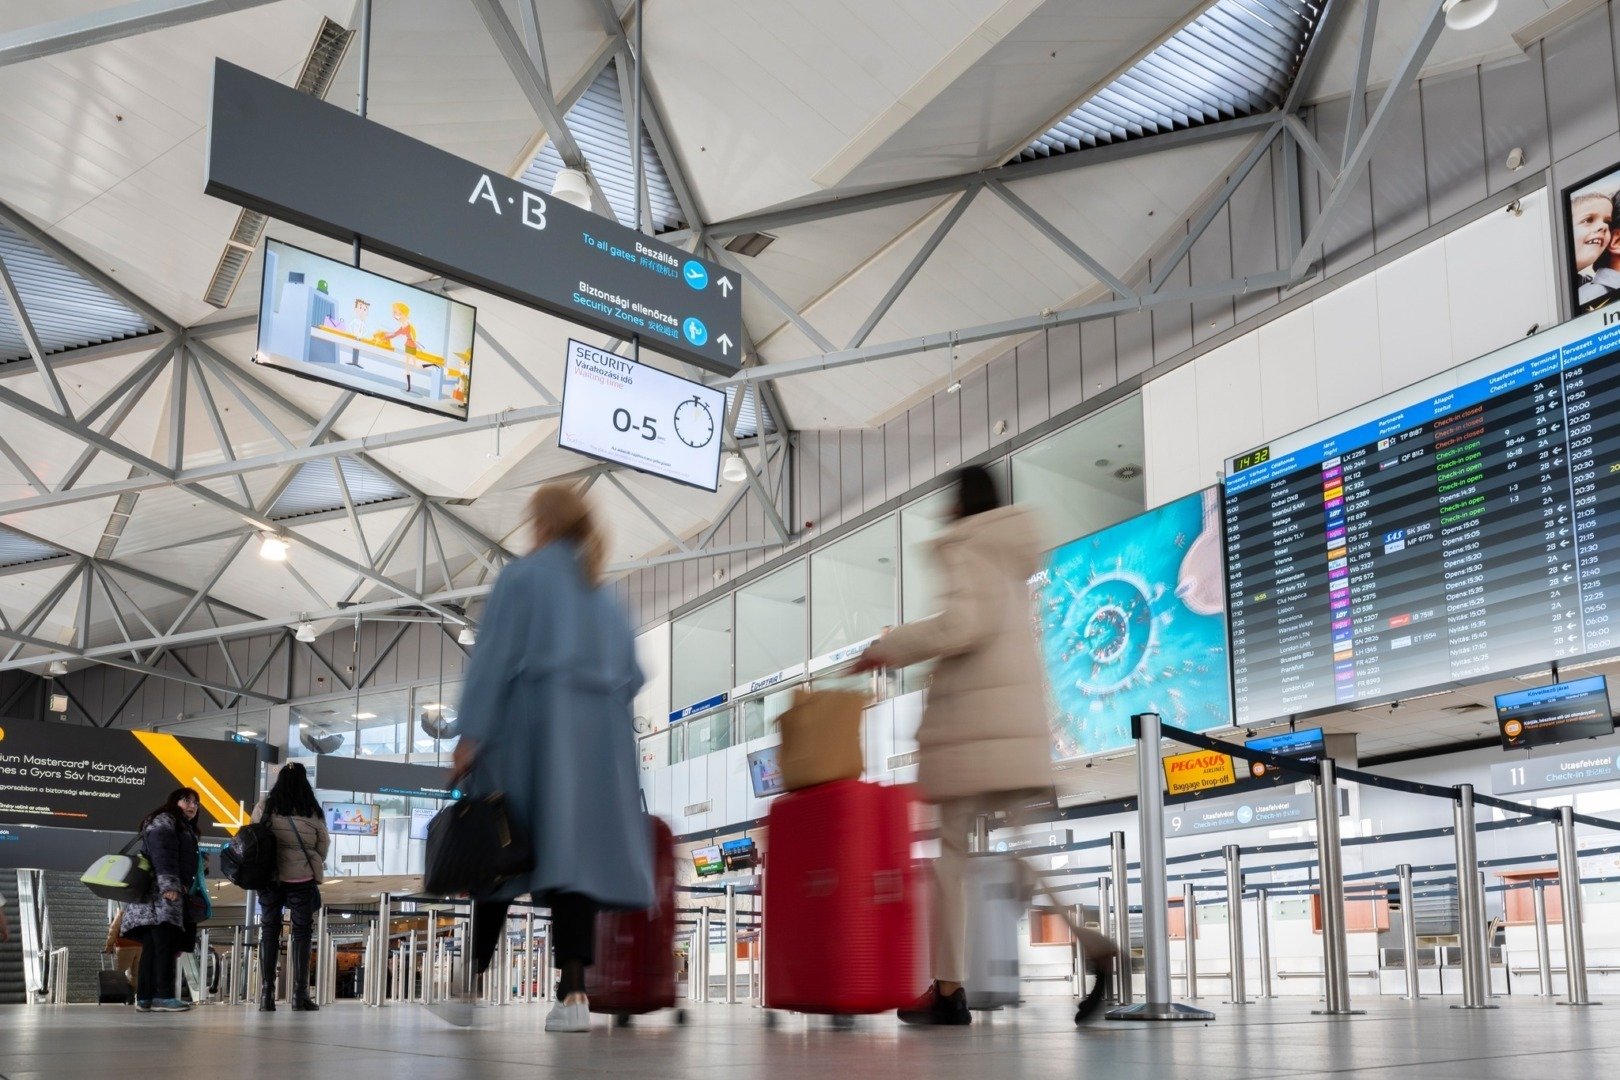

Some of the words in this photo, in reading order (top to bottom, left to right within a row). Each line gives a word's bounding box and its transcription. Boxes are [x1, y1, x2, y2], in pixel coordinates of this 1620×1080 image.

[582, 233, 595, 246] To
[598, 240, 608, 250] all
[610, 244, 636, 264] gates
[635, 241, 679, 267] Beszállás
[573, 292, 612, 316] Security
[614, 308, 644, 327] Zones
[580, 281, 630, 310] Biztonsági
[632, 298, 678, 326] ellenőrzés
[1563, 341, 1592, 355] Tervezett
[576, 348, 634, 374] SECURITY
[1564, 348, 1596, 364] Scheduled
[576, 358, 620, 380] Várakozási
[1532, 362, 1558, 376] Terminal
[1565, 368, 1582, 379] 19:45
[574, 367, 605, 385] Waiting
[606, 378, 624, 390] time
[1566, 379, 1583, 390] 19:45
[1490, 380, 1515, 392] Check-in
[1567, 390, 1585, 402] 19:50
[1434, 404, 1450, 414] Status
[1568, 401, 1590, 413] 20:00
[612, 408, 658, 441] 0-5
[1569, 413, 1590, 425] 20:20
[1434, 426, 1461, 438] Check-in
[1462, 416, 1483, 428] closed
[1570, 424, 1591, 436] 20:20
[1270, 479, 1286, 488] Zurich
[1434, 414, 1460, 427] Check-in
[1461, 406, 1482, 417] closed
[1533, 383, 1543, 391] 2A
[1435, 436, 1462, 449] Check-in
[1463, 427, 1484, 439] closed
[1571, 436, 1592, 448] 20:20
[1436, 447, 1463, 459] Check-in
[1464, 441, 1480, 450] open
[1572, 448, 1592, 460] 20:25
[1436, 458, 1464, 470] Check-in
[1465, 452, 1481, 460] open
[1573, 460, 1593, 471] 20:30
[1438, 468, 1464, 481] Check-in
[1466, 463, 1482, 471] open
[1574, 471, 1594, 483] 20:30
[1438, 479, 1465, 492] Check-in
[1466, 474, 1482, 482] open
[1574, 483, 1595, 495] 20:35
[1440, 501, 1467, 513] Check-in
[1468, 496, 1484, 504] open
[1576, 495, 1596, 506] 20:55
[1440, 512, 1468, 524] Check-in
[1469, 507, 1485, 515] open
[1577, 508, 1595, 518] 21:05
[1578, 520, 1596, 530] 21:05
[1578, 532, 1594, 542] 21:15
[1580, 544, 1598, 554] 21:30
[1581, 556, 1598, 565] 21:35
[1582, 567, 1600, 577] 21:40
[1583, 580, 1600, 590] 22:15
[1584, 591, 1603, 602] 22:25
[1584, 603, 1606, 613] 05:50
[1585, 615, 1608, 625] 06:00
[1586, 627, 1609, 637] 06:00
[1587, 639, 1611, 649] 06:00
[682, 707, 692, 717] LOT
[92, 761, 147, 775] kártyájával
[1170, 755, 1226, 773] PEGASUS
[1560, 757, 1611, 770] Utasfelvétel
[1203, 766, 1225, 774] AIRLINES
[1510, 766, 1525, 786] 11
[30, 768, 62, 780] Gyors
[64, 770, 85, 781] Sáv
[88, 772, 146, 786] használata!
[1546, 771, 1584, 782] Check-in
[1173, 781, 1200, 792] Baggage
[1202, 775, 1229, 787] Drop-off
[46, 787, 78, 798] biztonsági
[79, 790, 120, 799] ellenőrzéshez!
[1256, 802, 1290, 812] Utasfelvétel
[1203, 810, 1234, 820] Utasfelvétel
[1256, 812, 1281, 821] Check-in
[1172, 816, 1182, 831] 9
[1194, 820, 1218, 829] Check-in
[1049, 835, 1057, 846] 8
